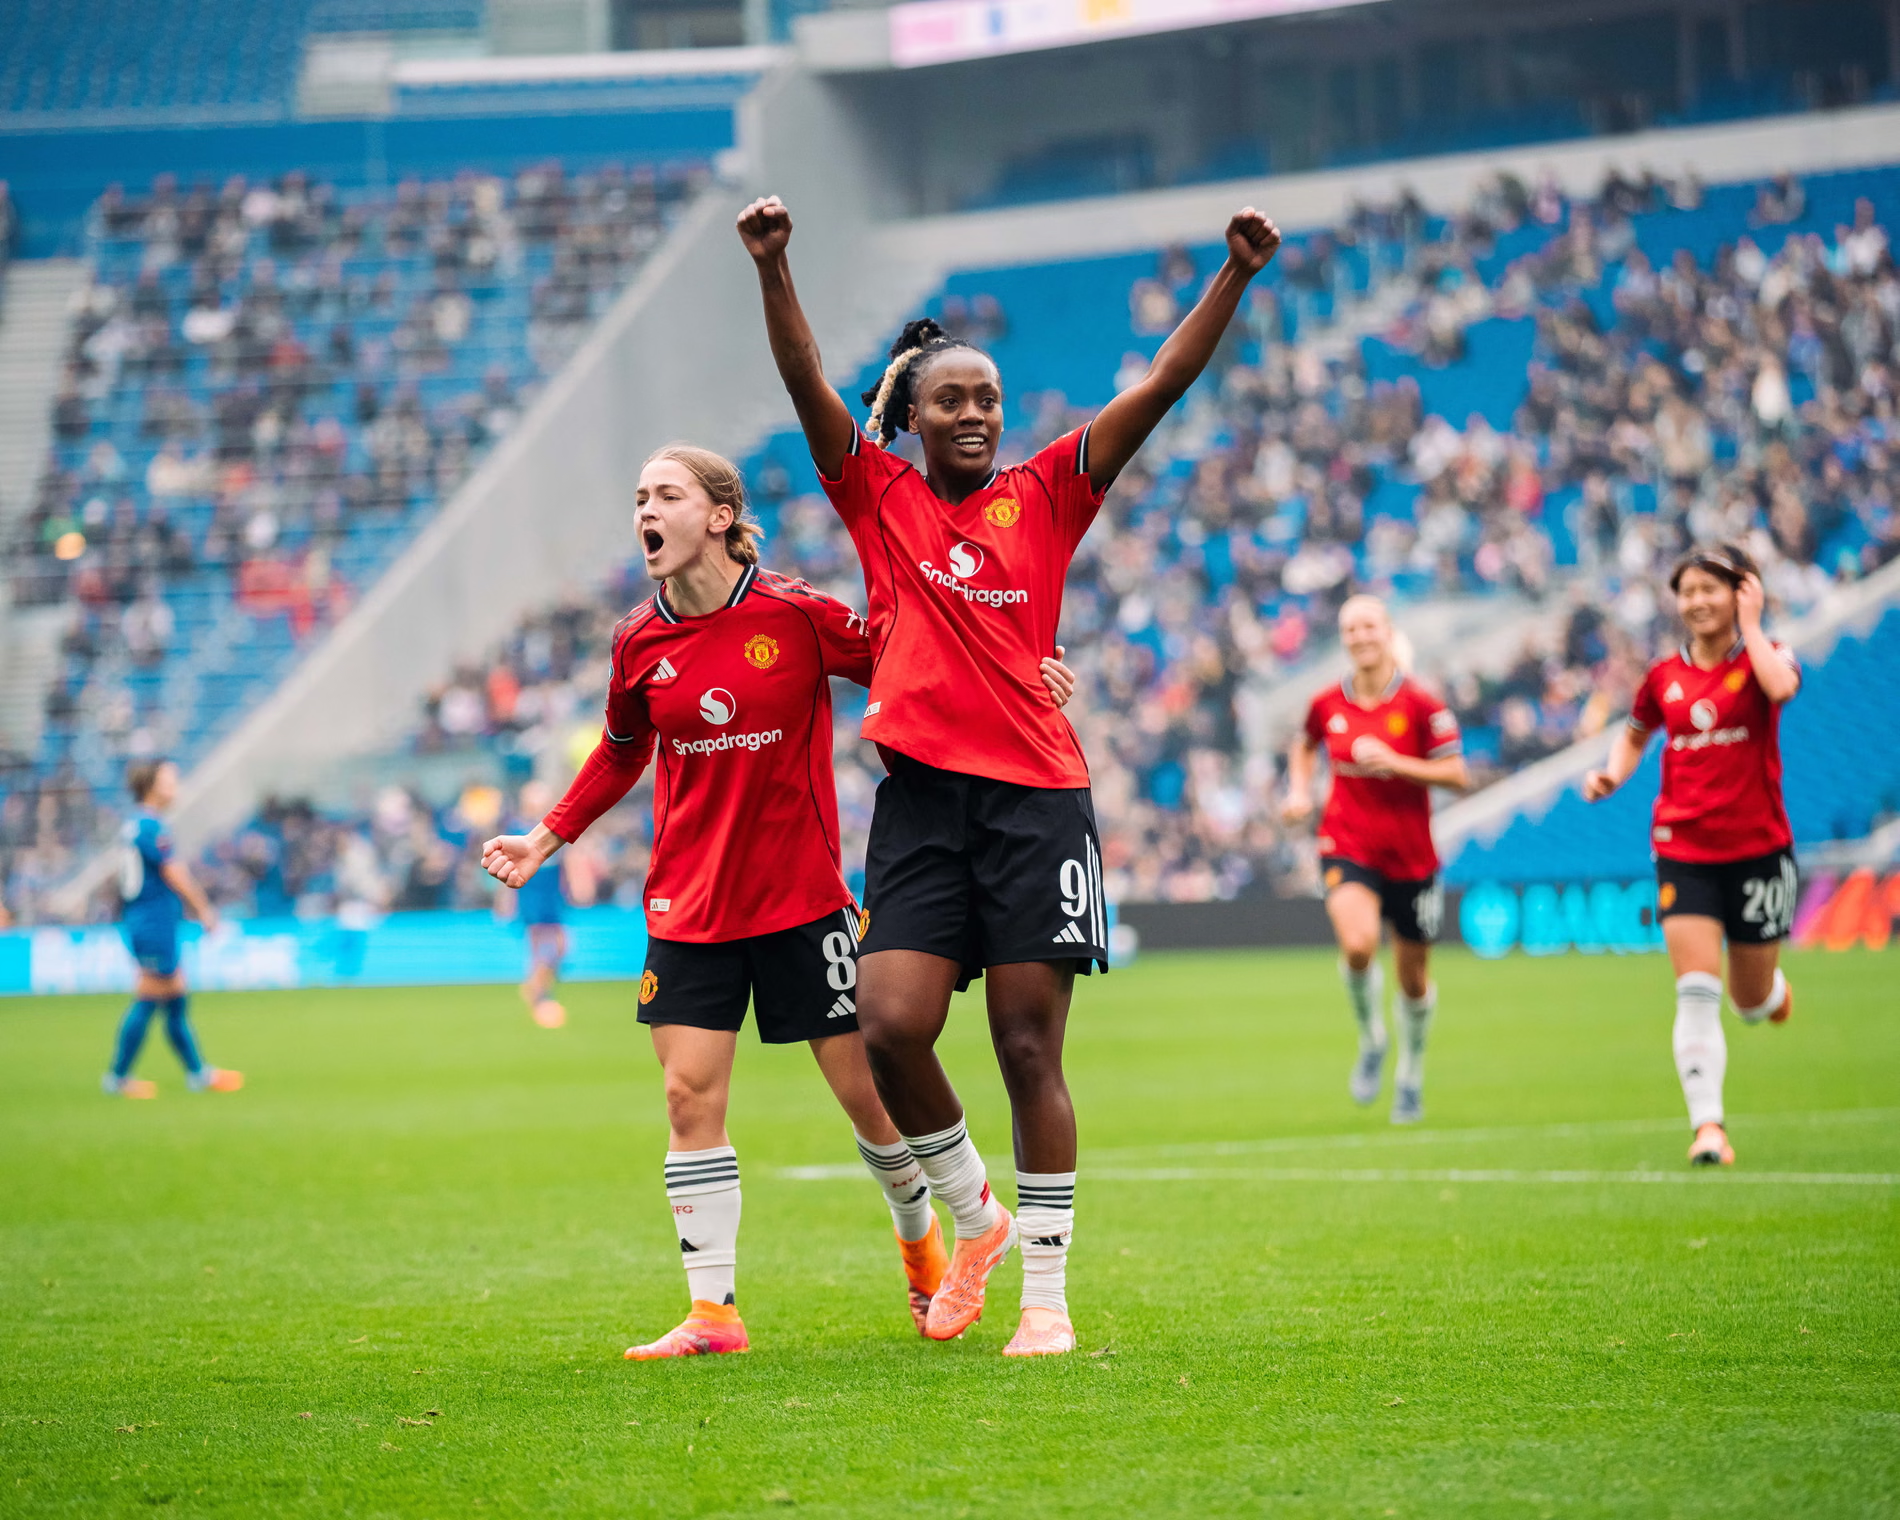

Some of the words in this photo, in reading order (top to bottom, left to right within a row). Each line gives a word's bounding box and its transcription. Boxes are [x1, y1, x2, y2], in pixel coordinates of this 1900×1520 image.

[919, 561, 1028, 608] Snapdragon
[672, 729, 782, 756] Snapdragon
[1059, 859, 1087, 917] 9
[1741, 876, 1785, 923] 20
[822, 931, 857, 991] 8
